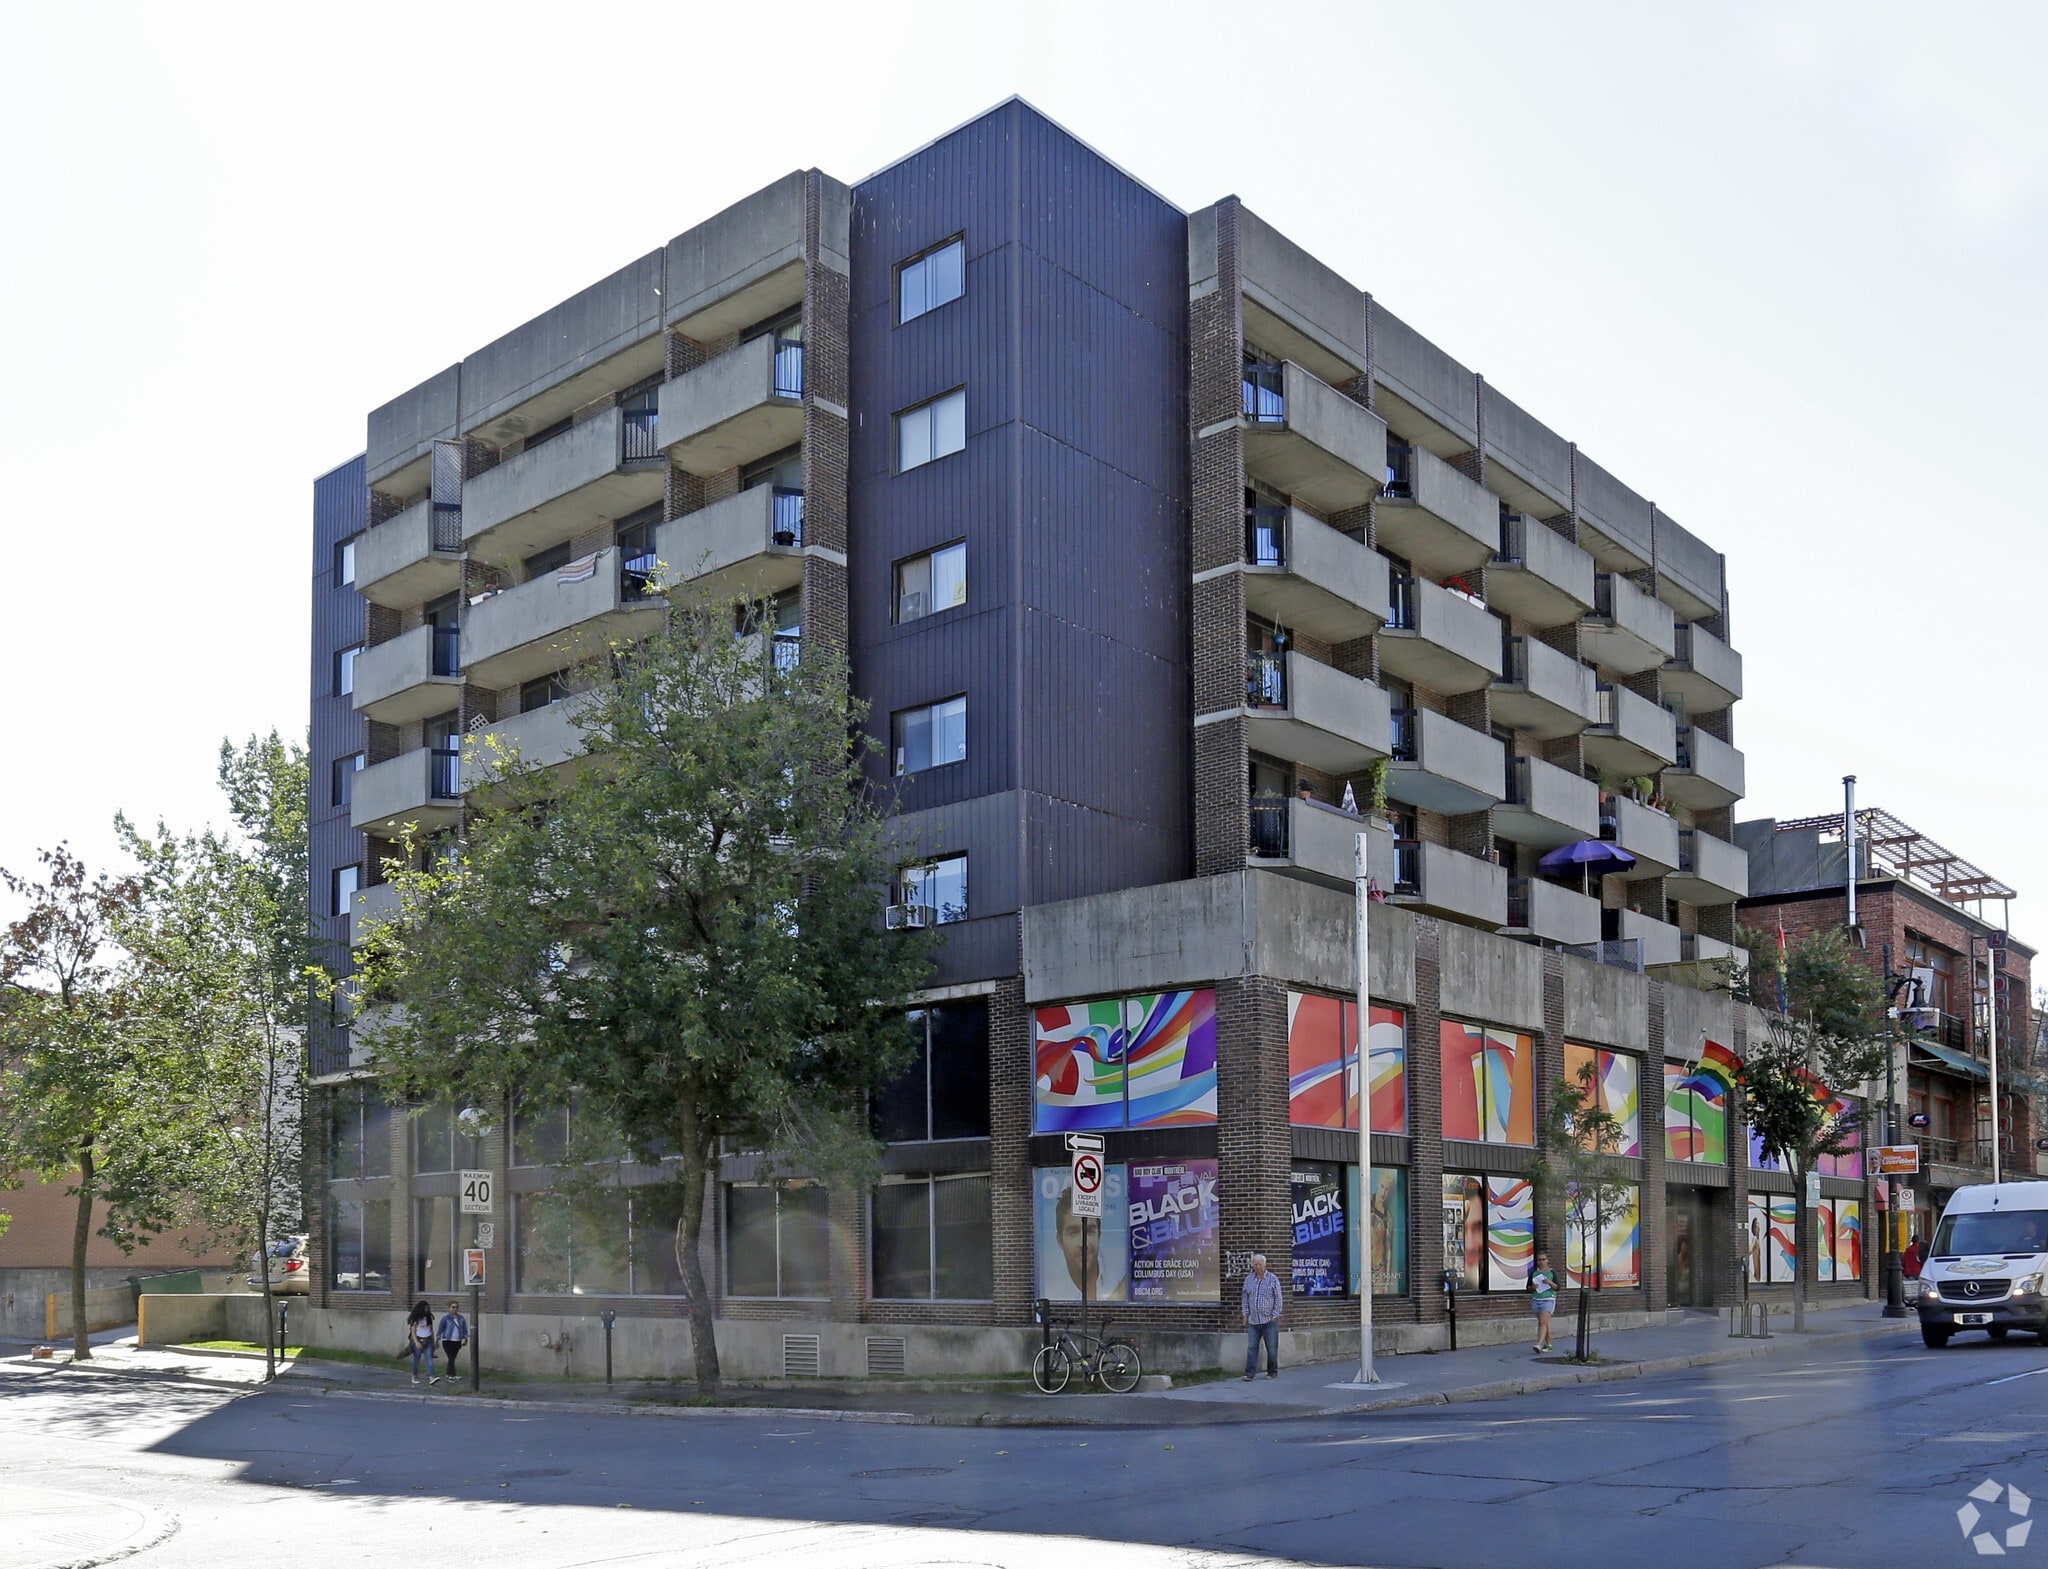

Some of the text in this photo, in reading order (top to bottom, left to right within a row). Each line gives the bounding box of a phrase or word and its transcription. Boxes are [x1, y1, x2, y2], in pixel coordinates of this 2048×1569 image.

[463, 1172, 490, 1180] MAXIMUM
[464, 1181, 490, 1202] 40
[1078, 1205, 1095, 1213] LOCALE
[1129, 1180, 1219, 1226] BLACK
[1291, 1190, 1342, 1224] LACK
[1132, 1205, 1219, 1250] & BLUE
[1295, 1211, 1344, 1245] BLUE
[1134, 1260, 1154, 1268] ACTION
[1155, 1260, 1162, 1268] DE
[1182, 1259, 1199, 1269] (CAN)
[1134, 1269, 1194, 1279] COLUMBUS DAY (USA)
